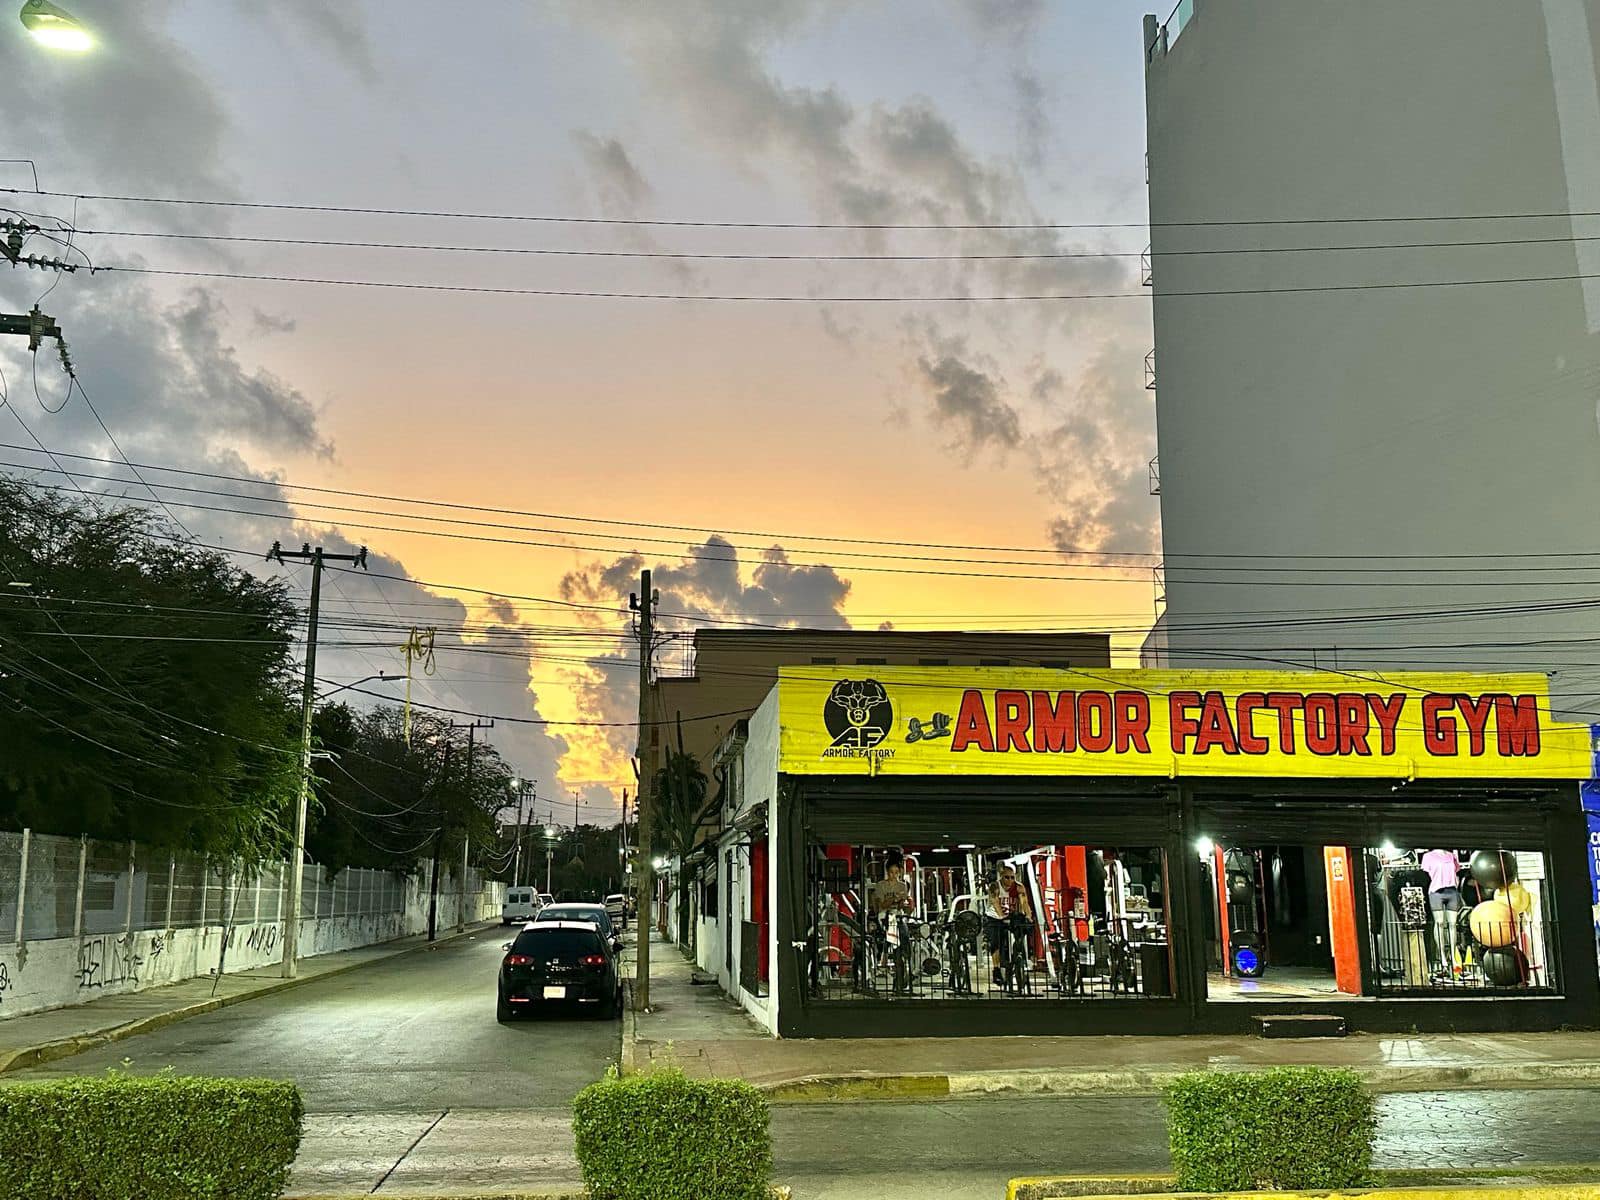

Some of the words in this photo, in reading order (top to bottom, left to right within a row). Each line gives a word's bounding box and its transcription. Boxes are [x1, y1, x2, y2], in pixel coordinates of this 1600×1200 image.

[951, 690, 1151, 754] ARMOR
[1168, 691, 1407, 755] FACTORY
[1422, 693, 1541, 757] GYM
[830, 727, 885, 748] AF
[822, 748, 854, 758] ARMOR
